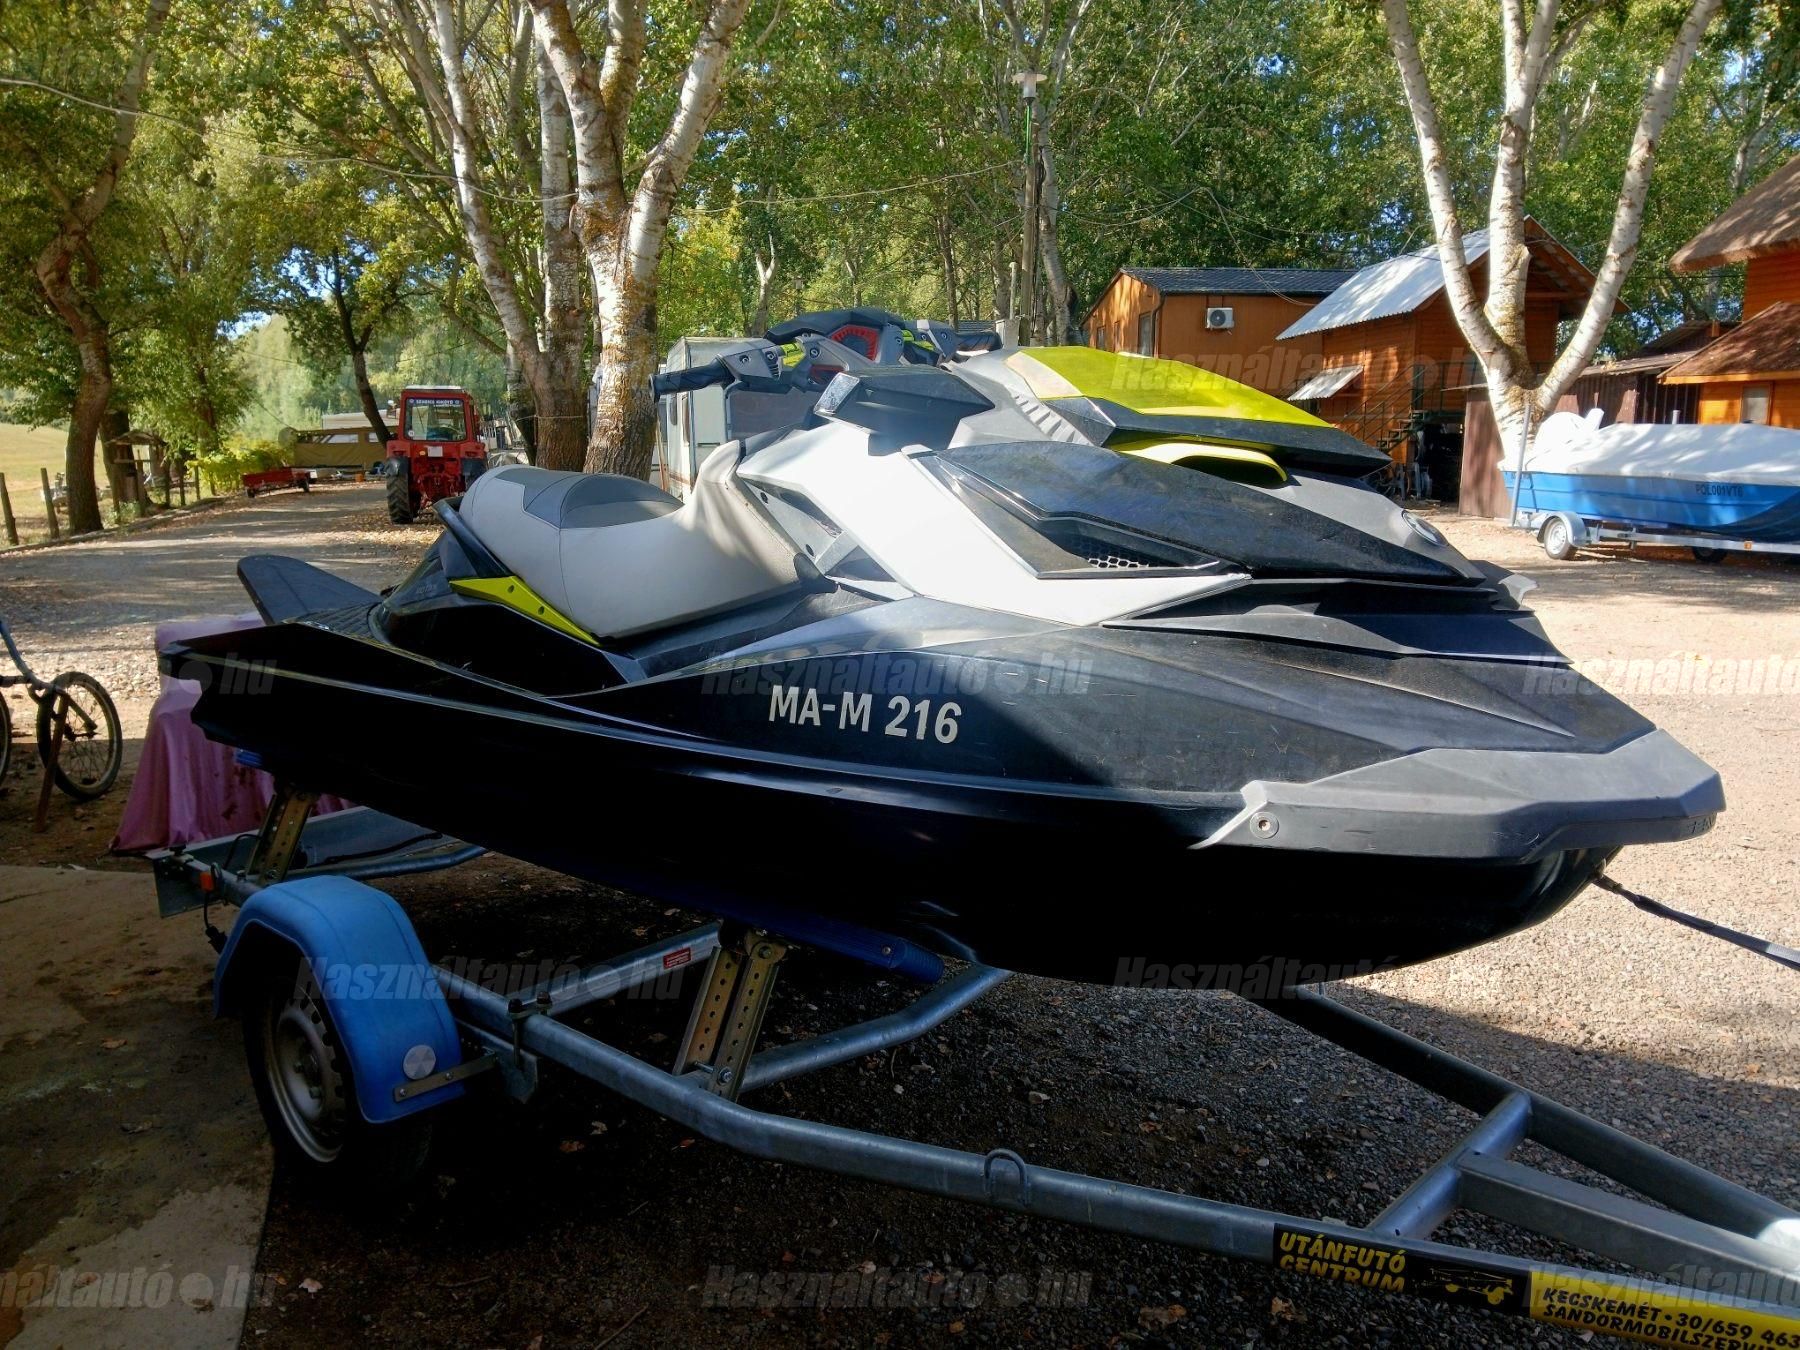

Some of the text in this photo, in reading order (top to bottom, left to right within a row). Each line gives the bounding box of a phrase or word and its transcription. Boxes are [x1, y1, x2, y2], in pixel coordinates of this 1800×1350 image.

[769, 685, 962, 744] MA-M 216
[1279, 1231, 1407, 1274] UTÁNFUTÓ
[1279, 1254, 1405, 1293] CENTRUM
[1543, 1287, 1662, 1321] KECSKEMÉT
[1675, 1312, 1753, 1340] 30/659
